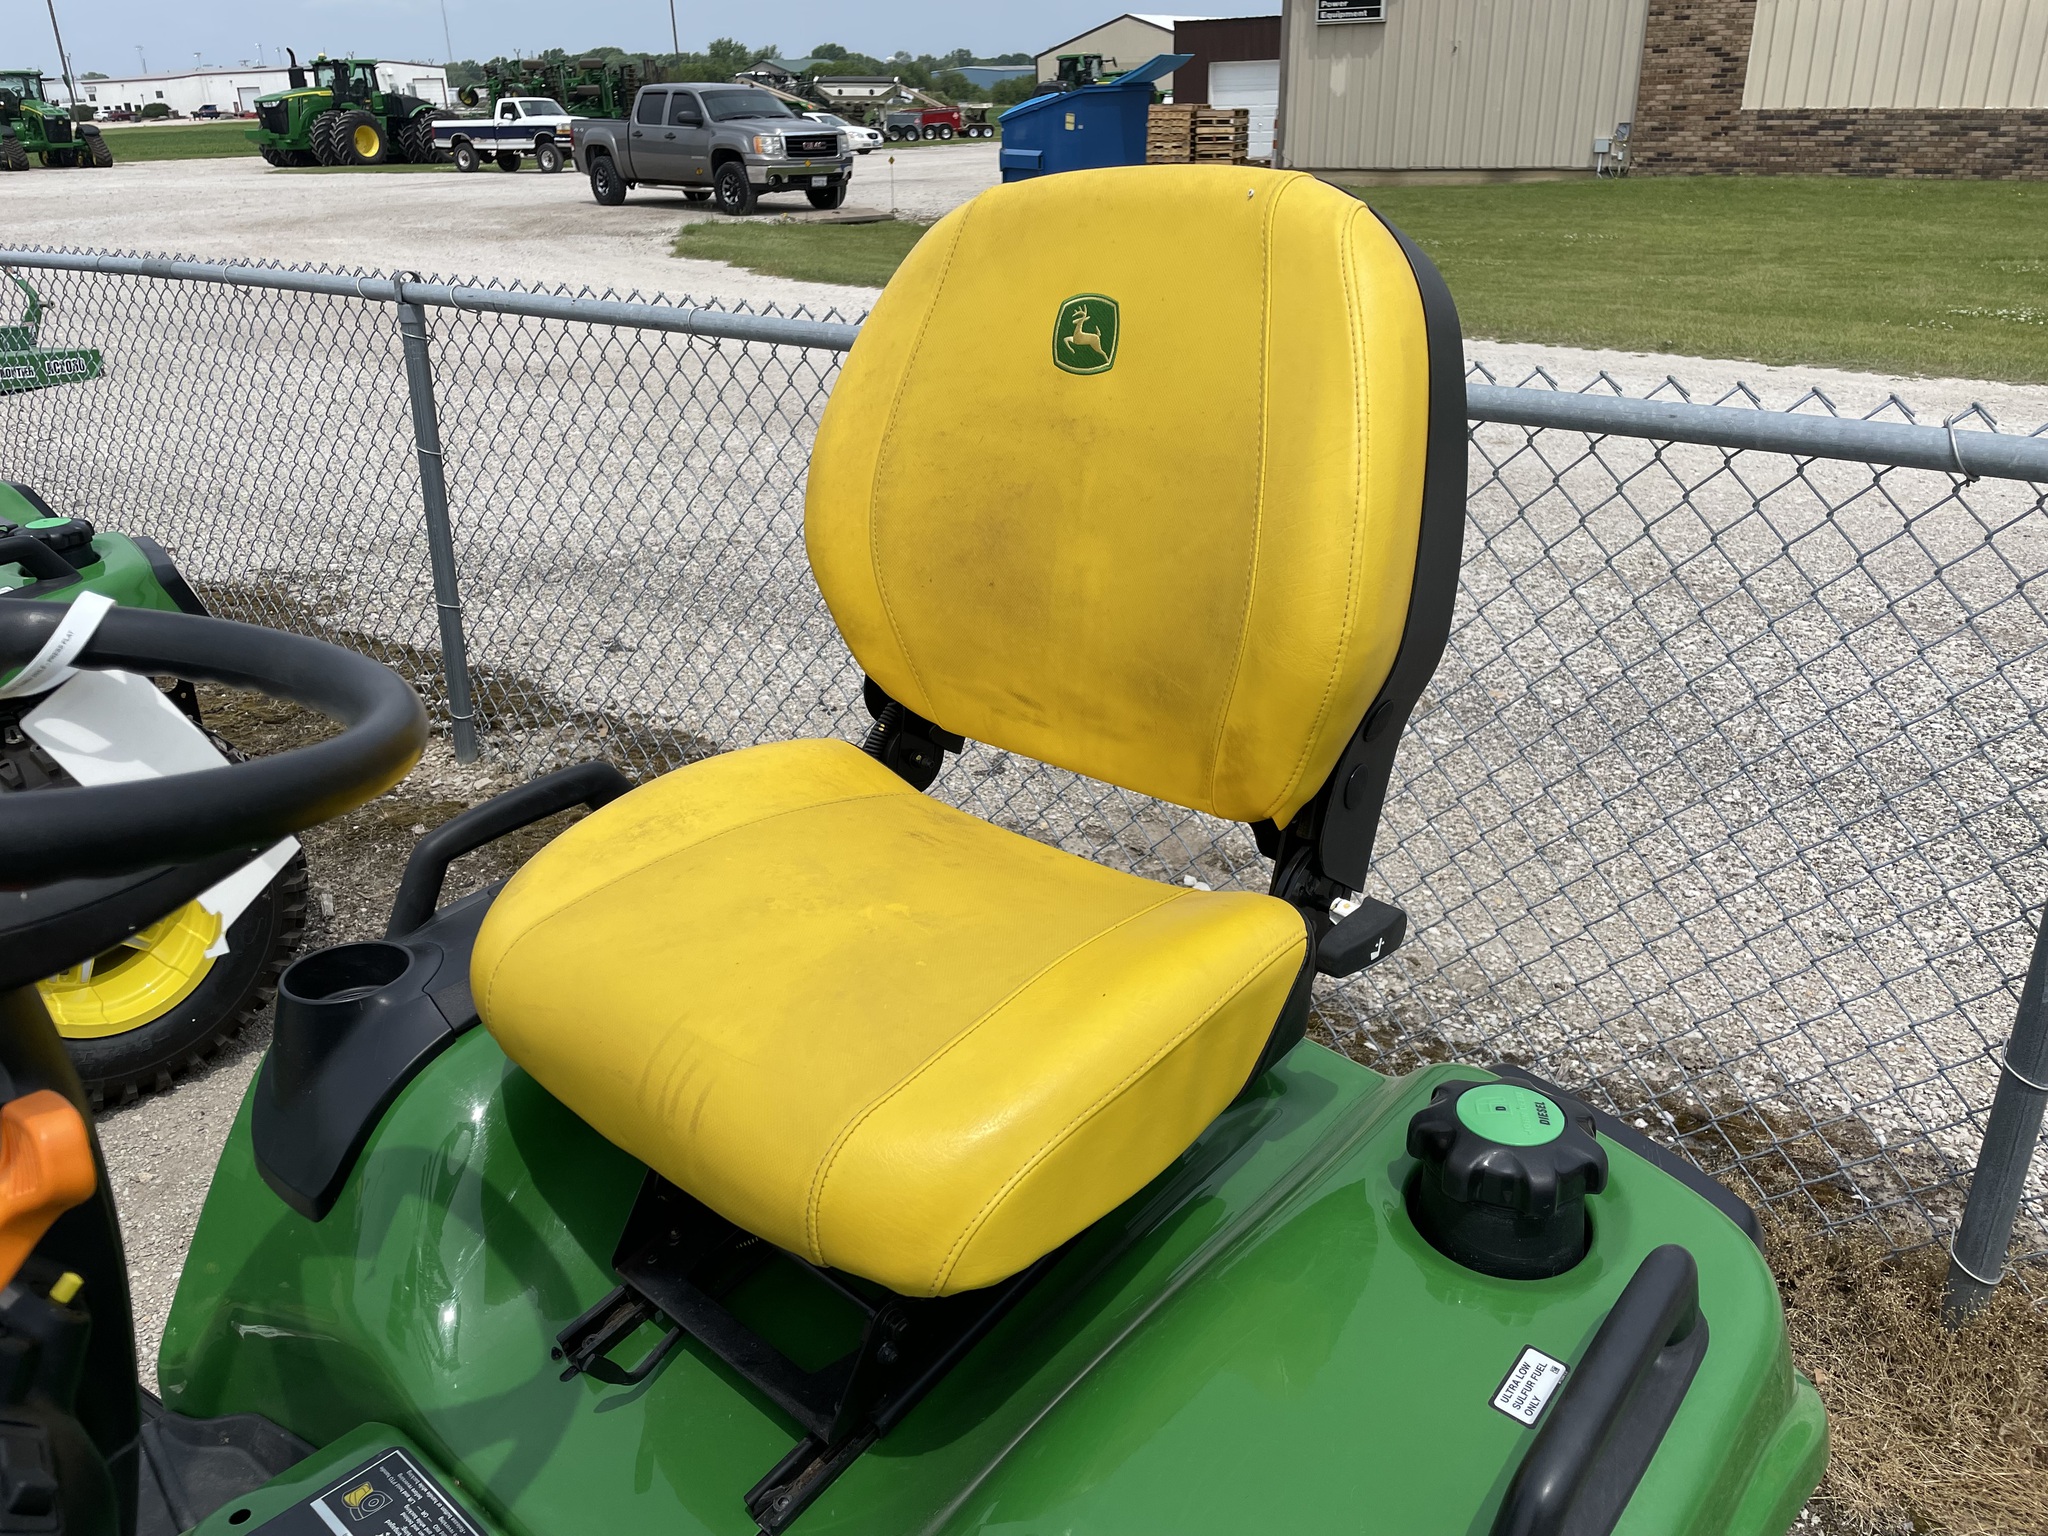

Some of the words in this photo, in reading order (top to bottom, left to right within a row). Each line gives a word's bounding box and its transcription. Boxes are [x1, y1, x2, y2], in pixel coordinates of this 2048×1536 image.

[1320, 0, 1349, 8] Power
[1320, 10, 1368, 19] Equipment
[1534, 1101, 1551, 1126] DIESEL
[1500, 1378, 1521, 1404] ULTRA
[1515, 1361, 1532, 1380] LOW
[1512, 1380, 1536, 1411] SULFUR
[1530, 1362, 1548, 1382] FUEL
[1524, 1395, 1542, 1417] ONLY
[403, 1503, 418, 1520] backing
[440, 1505, 453, 1520] button
[415, 1517, 426, 1528] while
